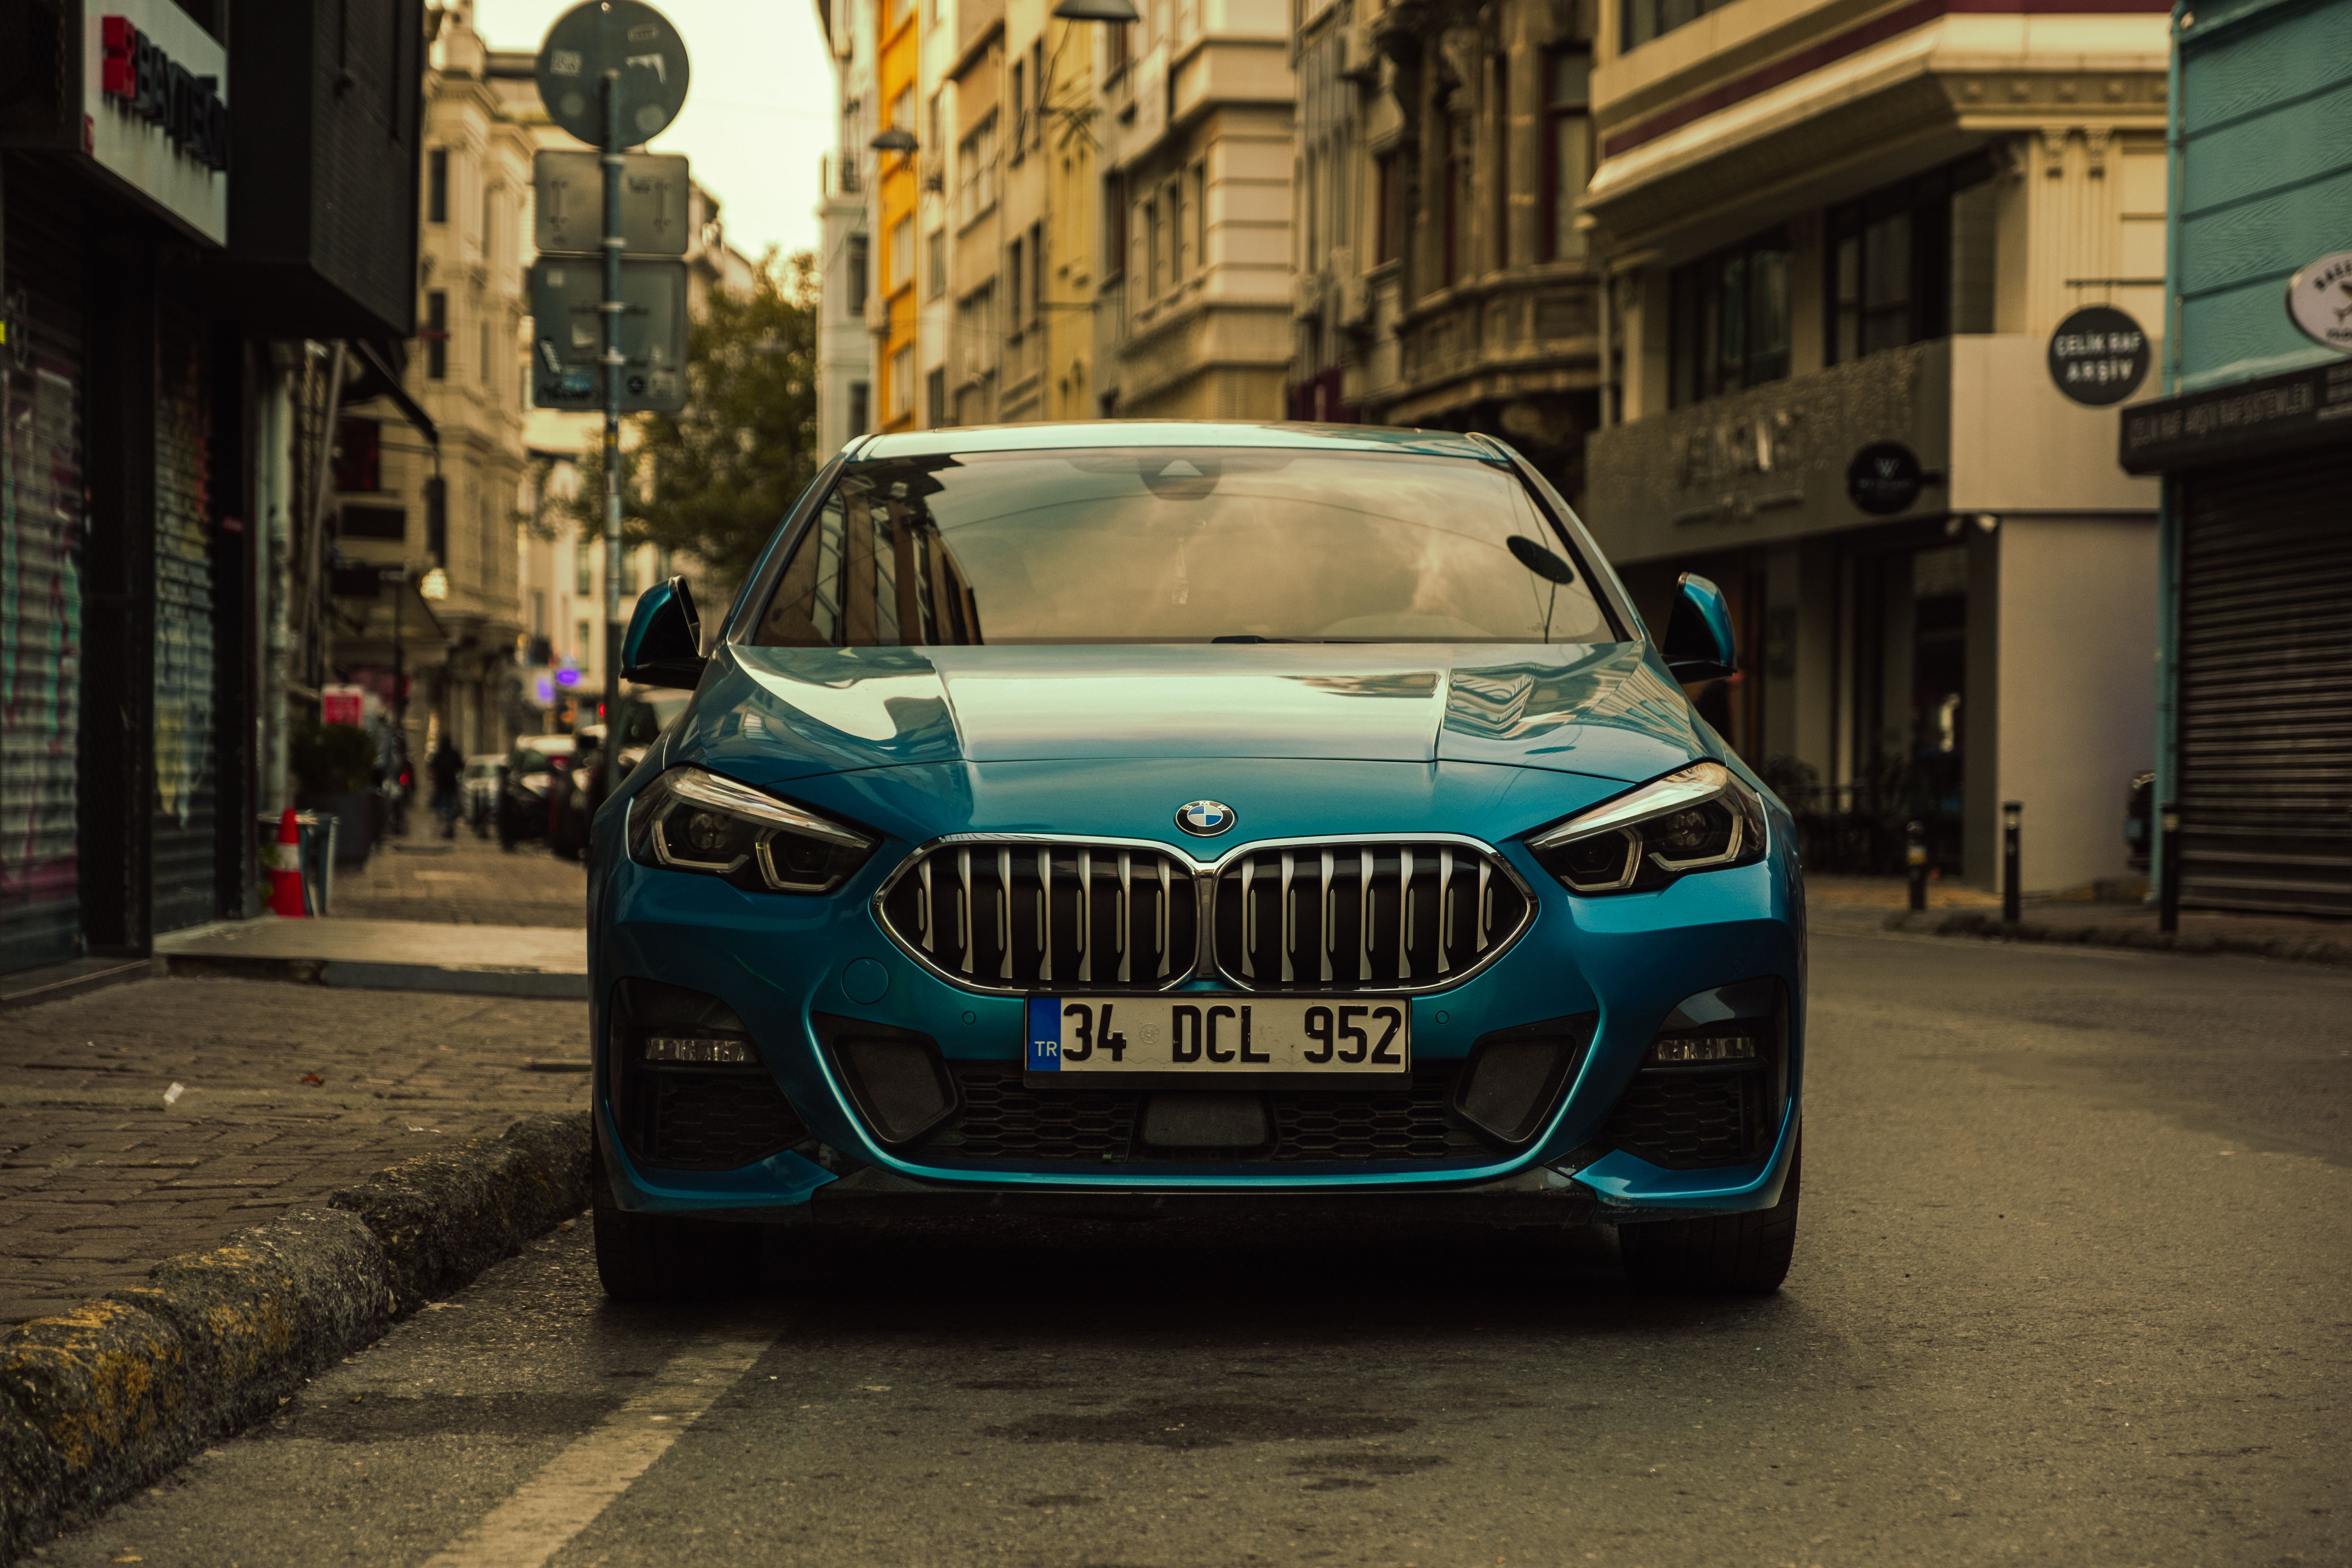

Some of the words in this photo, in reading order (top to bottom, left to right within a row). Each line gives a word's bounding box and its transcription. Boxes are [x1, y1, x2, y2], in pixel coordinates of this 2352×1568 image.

[1182, 801, 1228, 811] BMW
[1063, 1003, 1126, 1062] 34
[1172, 1005, 1270, 1064] DCL
[1304, 1005, 1402, 1064] 952
[1035, 1041, 1057, 1057] TR
